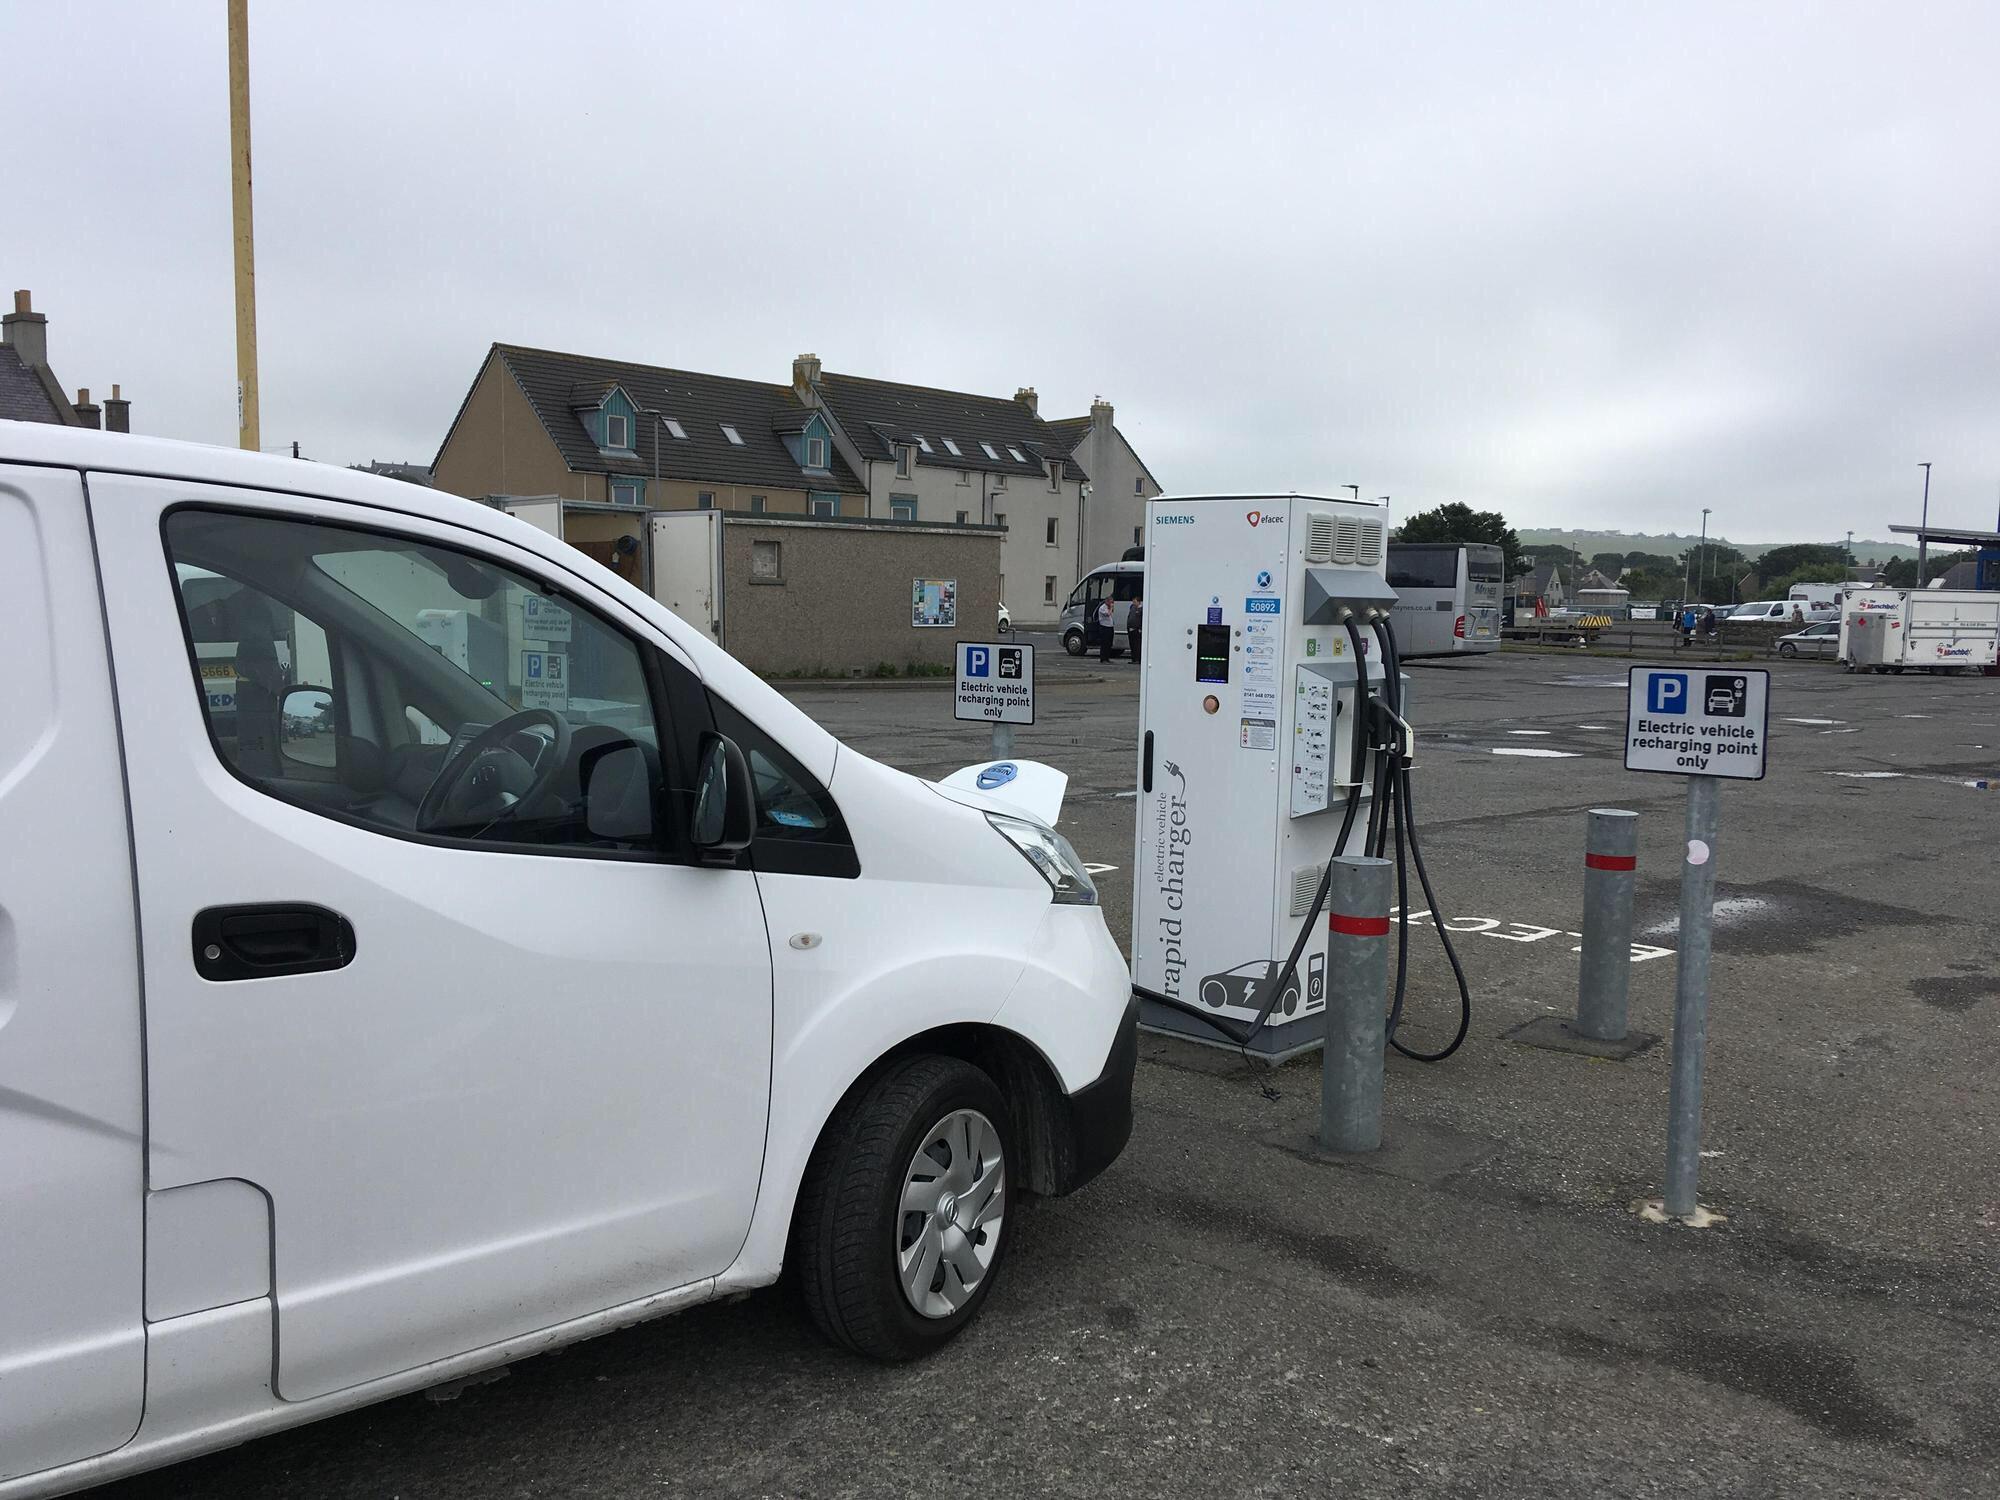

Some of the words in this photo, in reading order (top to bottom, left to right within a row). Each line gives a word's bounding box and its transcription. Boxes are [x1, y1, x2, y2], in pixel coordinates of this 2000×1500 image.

[1156, 515, 1195, 525] SIEMENS
[1260, 514, 1284, 524] efacec
[1250, 602, 1276, 612] 50892
[972, 650, 986, 674] P
[961, 681, 994, 693] Electric
[996, 684, 1028, 695] vehicle
[1657, 678, 1682, 709] P
[958, 694, 1004, 707] recharging
[1006, 696, 1030, 707] point
[983, 707, 1003, 718] only
[1638, 719, 1695, 736] Electric
[1699, 724, 1755, 739] vehicle
[1632, 737, 1712, 755] recharging
[1717, 741, 1758, 756] point
[1676, 755, 1709, 770] only
[1156, 792, 1167, 835] vehicle
[1154, 838, 1165, 883] electric
[1160, 795, 1192, 911] charger
[1160, 917, 1187, 998] rapid
